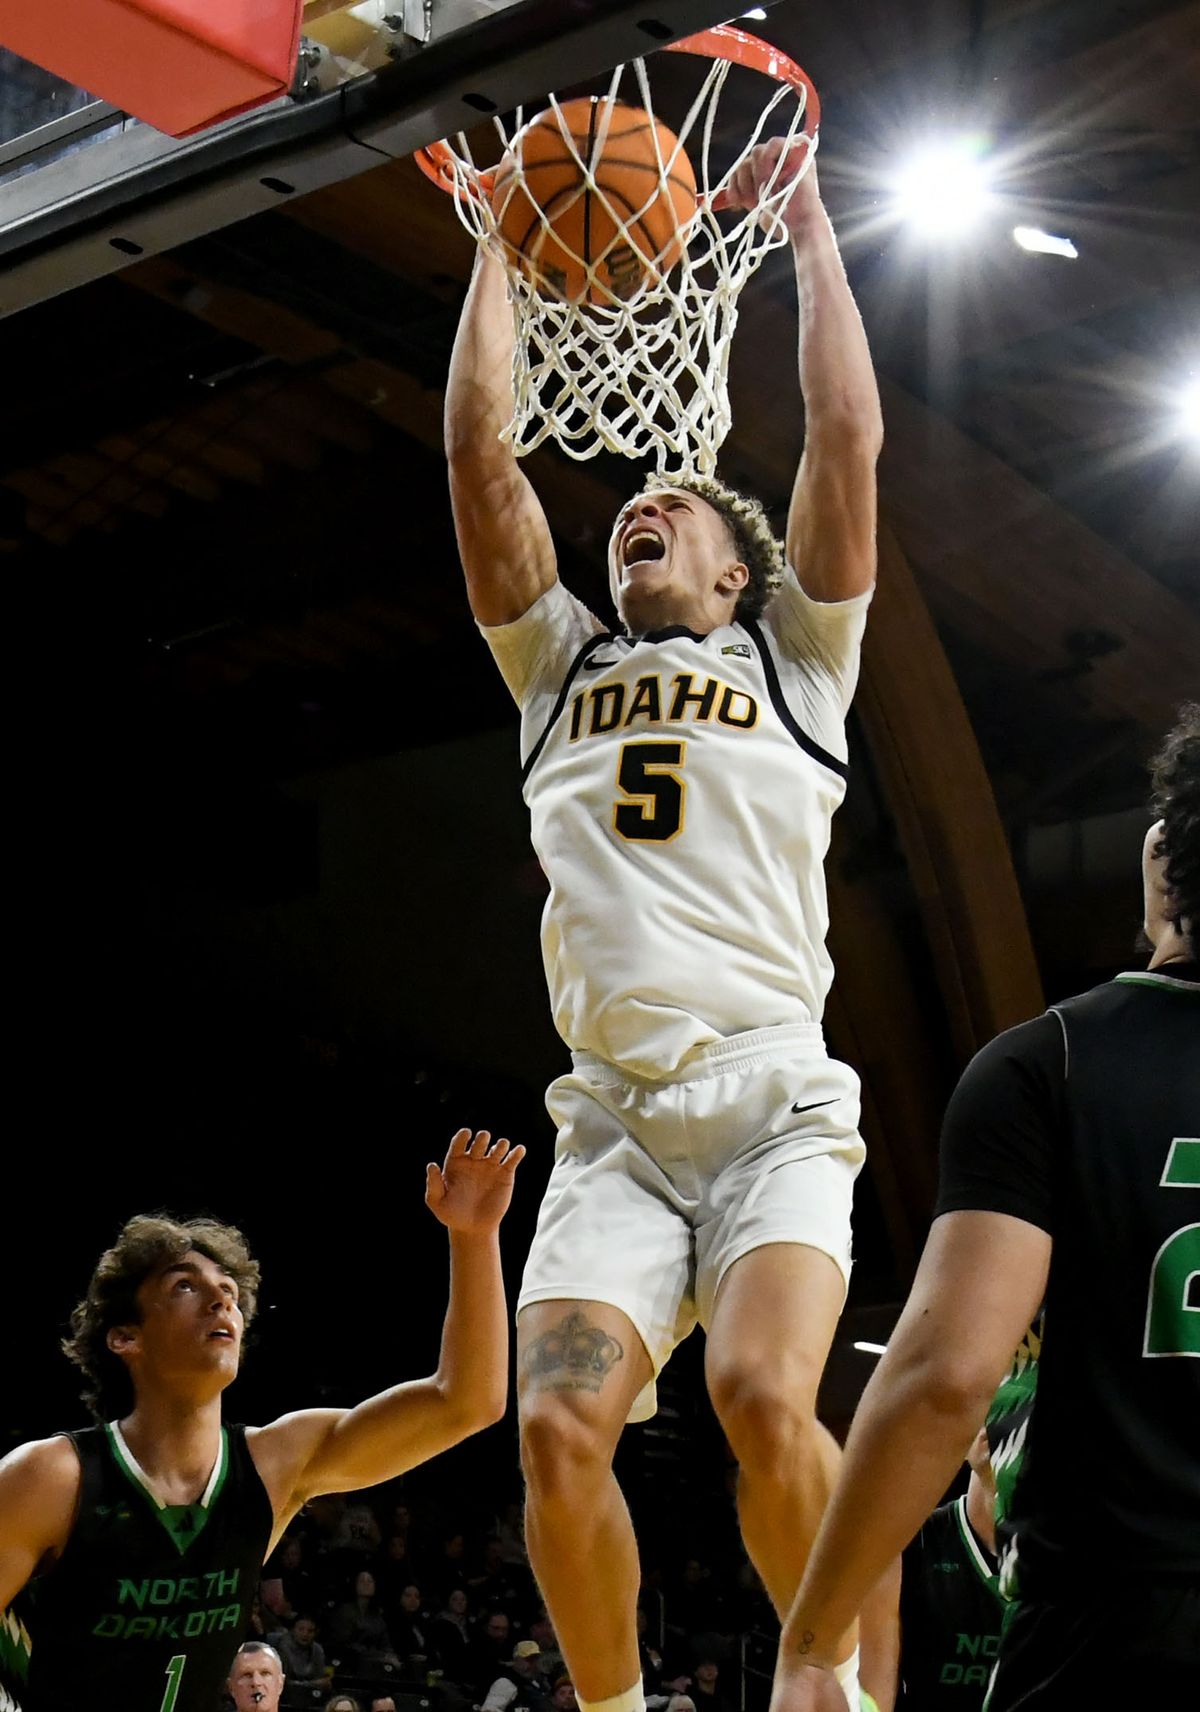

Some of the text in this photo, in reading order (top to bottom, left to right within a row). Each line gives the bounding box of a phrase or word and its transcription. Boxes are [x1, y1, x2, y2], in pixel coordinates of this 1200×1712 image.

[568, 673, 758, 743] IDAHO
[612, 739, 687, 844] 5
[116, 1567, 240, 1611] NORTH
[92, 1603, 241, 1640] DAKOTA
[160, 1654, 187, 1712] 1
